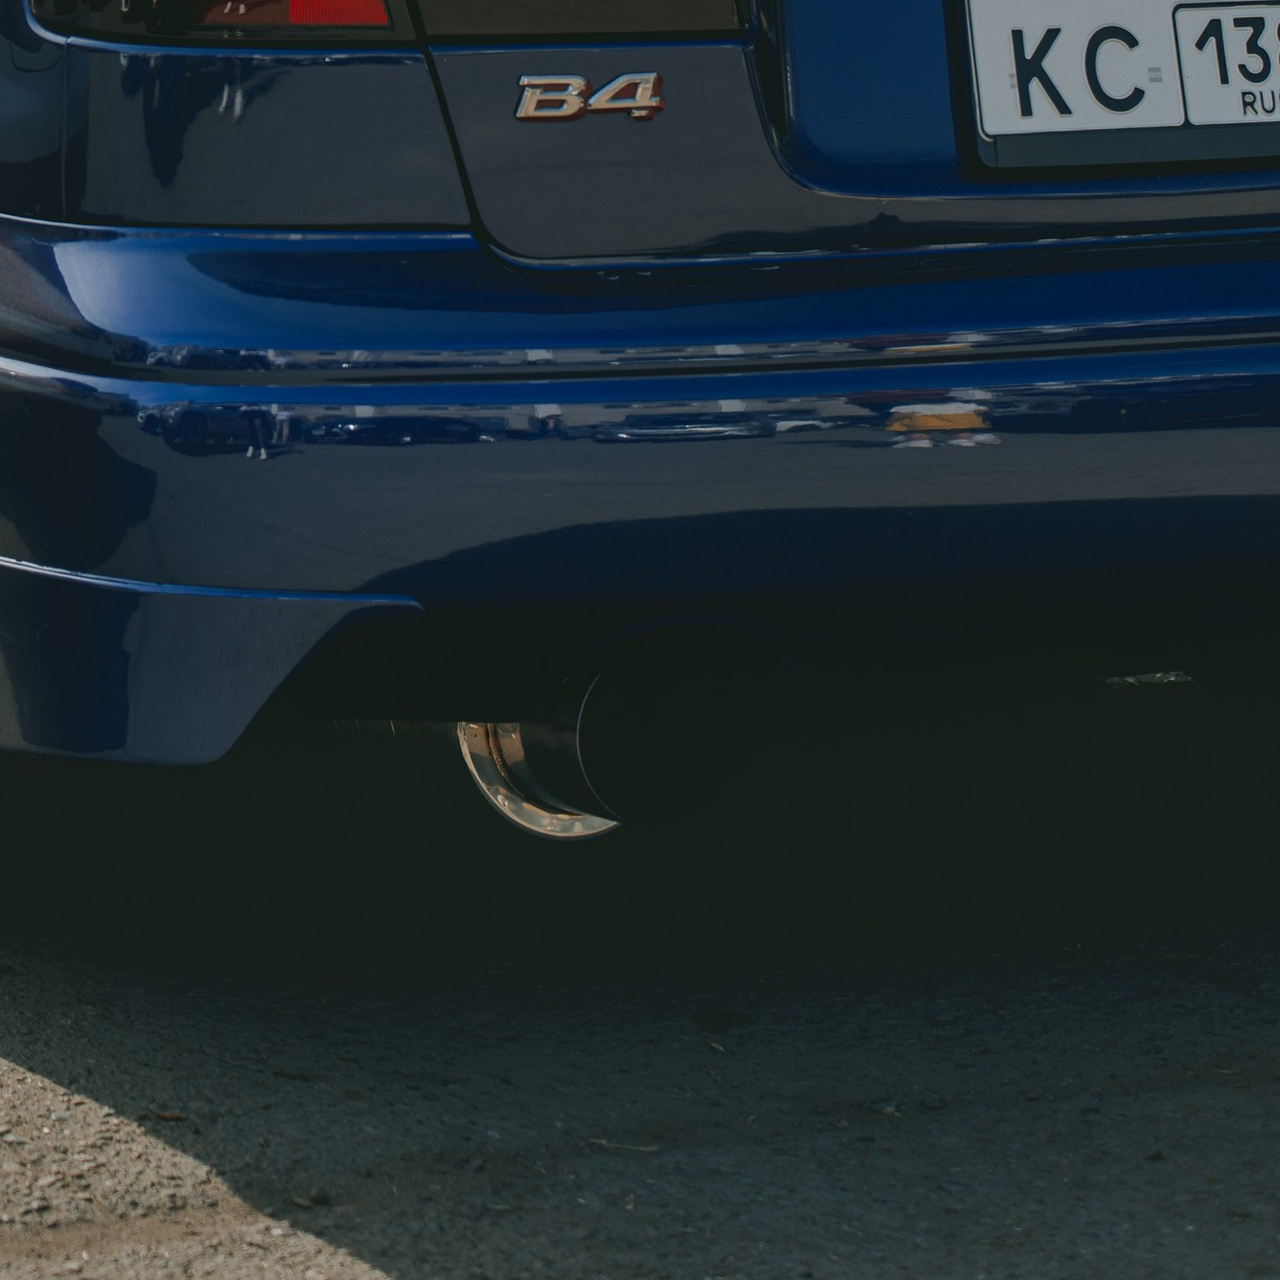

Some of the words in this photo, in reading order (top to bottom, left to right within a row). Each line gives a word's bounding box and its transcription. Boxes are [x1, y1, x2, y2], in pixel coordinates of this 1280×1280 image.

[1011, 24, 1146, 118] KC
[1195, 16, 1280, 85] 13
[516, 72, 662, 119] B4
[1241, 90, 1280, 115] RU
